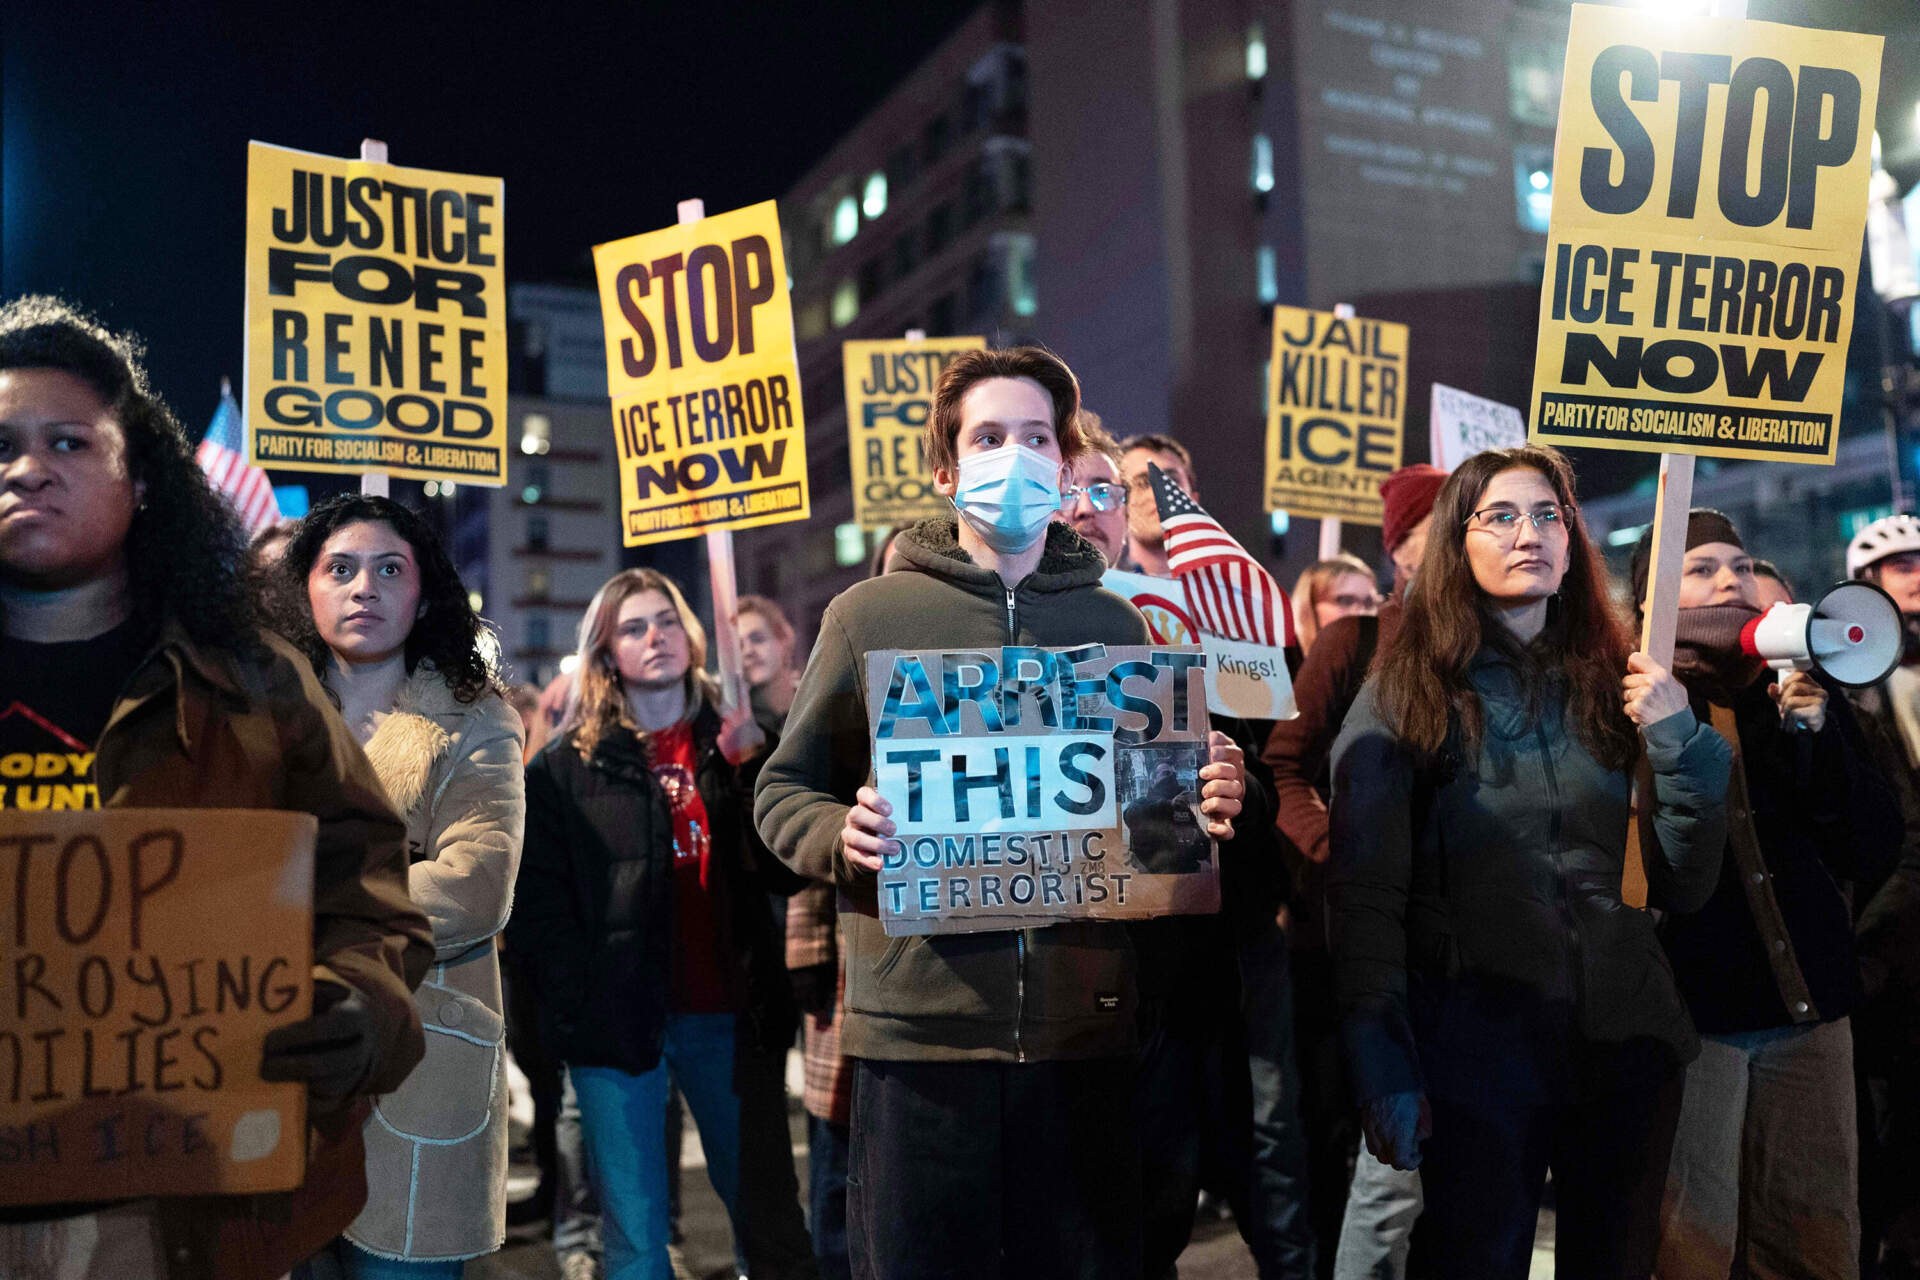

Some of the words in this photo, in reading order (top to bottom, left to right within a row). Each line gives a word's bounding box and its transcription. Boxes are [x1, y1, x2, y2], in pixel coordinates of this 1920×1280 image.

[1580, 44, 1861, 230] STOP
[273, 169, 496, 267] JUSTICE
[268, 247, 487, 319] FOR
[616, 234, 775, 379] STOP
[1551, 243, 1640, 326] ICE
[1650, 250, 1845, 344] TERROR
[272, 309, 488, 399] RENEE
[862, 352, 960, 395] JUST
[1282, 316, 1399, 361] JAIL
[1560, 332, 1825, 403] NOW
[264, 386, 494, 440] GOOD
[620, 401, 665, 459] ICE
[667, 374, 794, 449] TERROR
[1279, 350, 1398, 420] KILLER
[259, 435, 305, 457] PARTY
[305, 439, 332, 459] FOR
[333, 440, 404, 464] SOCIALISM
[406, 445, 424, 464] &
[424, 446, 496, 471] LIBERATION
[1279, 414, 1396, 472] ICE
[1543, 402, 1597, 431] PARTY
[1596, 405, 1630, 431] FOR
[1630, 407, 1715, 438] SOCIALISM
[1717, 415, 1736, 440] &
[1738, 416, 1825, 447] LIBERATION
[635, 438, 788, 500] NOW
[729, 497, 744, 517] &
[876, 643, 1207, 746] ARREST
[1216, 653, 1277, 681] Kings!
[0, 752, 96, 778] ODY
[886, 742, 1106, 823] THIS
[884, 831, 1106, 870] DOMESTIC
[0, 827, 185, 950] TOP
[884, 873, 1132, 914] TERRORIST
[15, 953, 299, 1026] ROYING
